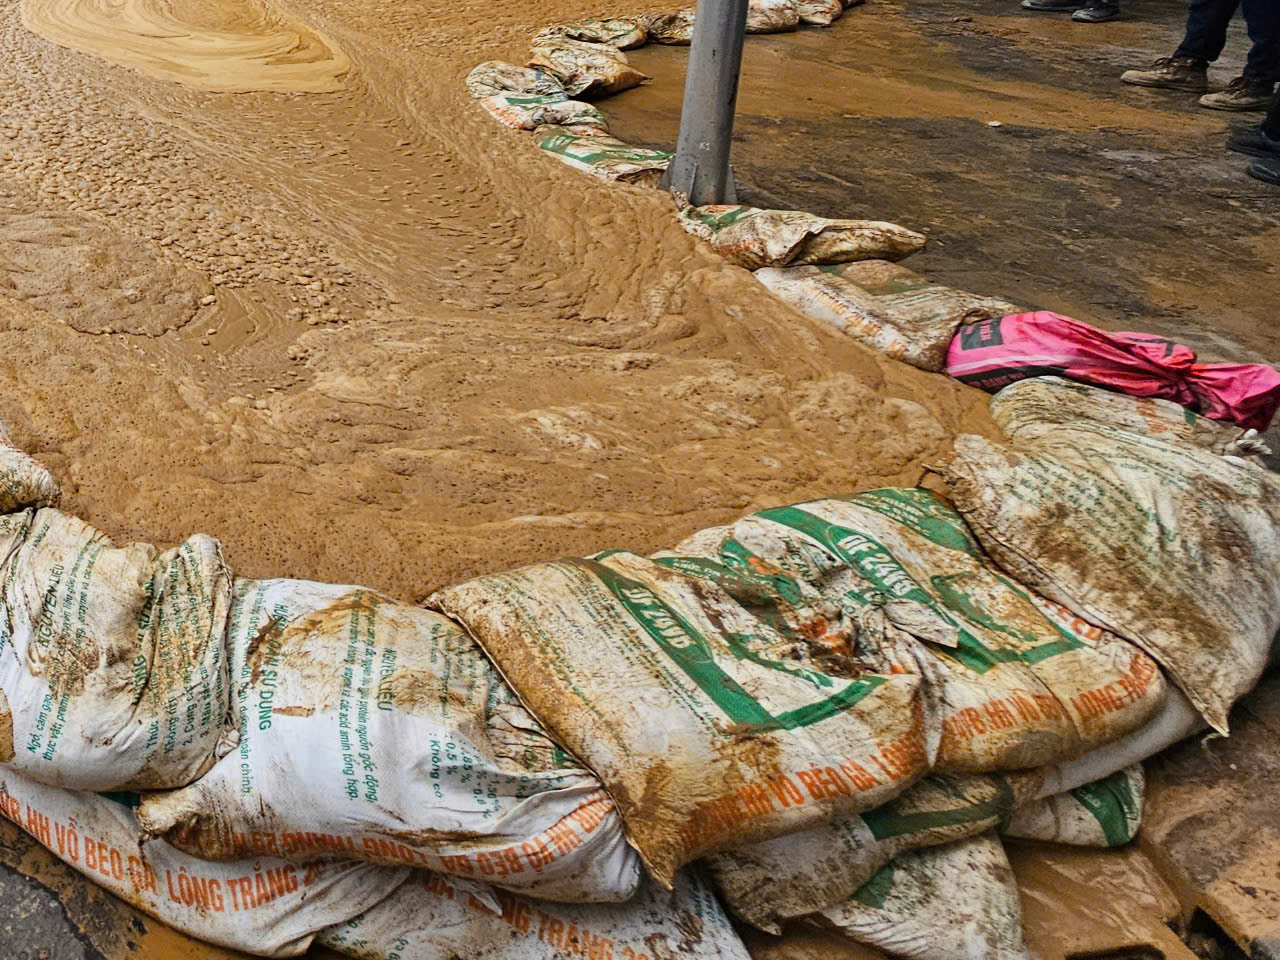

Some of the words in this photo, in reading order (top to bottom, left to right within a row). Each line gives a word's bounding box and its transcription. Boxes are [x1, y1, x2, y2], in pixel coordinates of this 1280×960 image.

[27, 585, 69, 648] NGUYÊN
[48, 562, 66, 584] LIỆU
[260, 670, 278, 688] SỬ
[339, 698, 352, 711] các
[374, 676, 397, 712] LIỆU
[33, 710, 48, 731] cám
[254, 690, 272, 730] DỤNG
[337, 712, 352, 729] acid
[357, 700, 370, 723] protein
[42, 739, 58, 761] thực
[338, 728, 352, 751] amin
[354, 724, 372, 752] nguồn
[358, 752, 377, 773] gốc
[424, 739, 445, 780] Không
[443, 741, 457, 761] 0,5
[340, 751, 360, 776] tổng
[343, 777, 360, 802] hợp.
[363, 774, 380, 803] động,
[431, 782, 444, 799] có
[798, 760, 850, 801] BÉO
[26, 807, 53, 847] HH
[54, 816, 81, 863] VỖ
[85, 833, 124, 882] BÉO
[167, 867, 225, 913] LÔNG
[227, 862, 299, 912] TRẮNG
